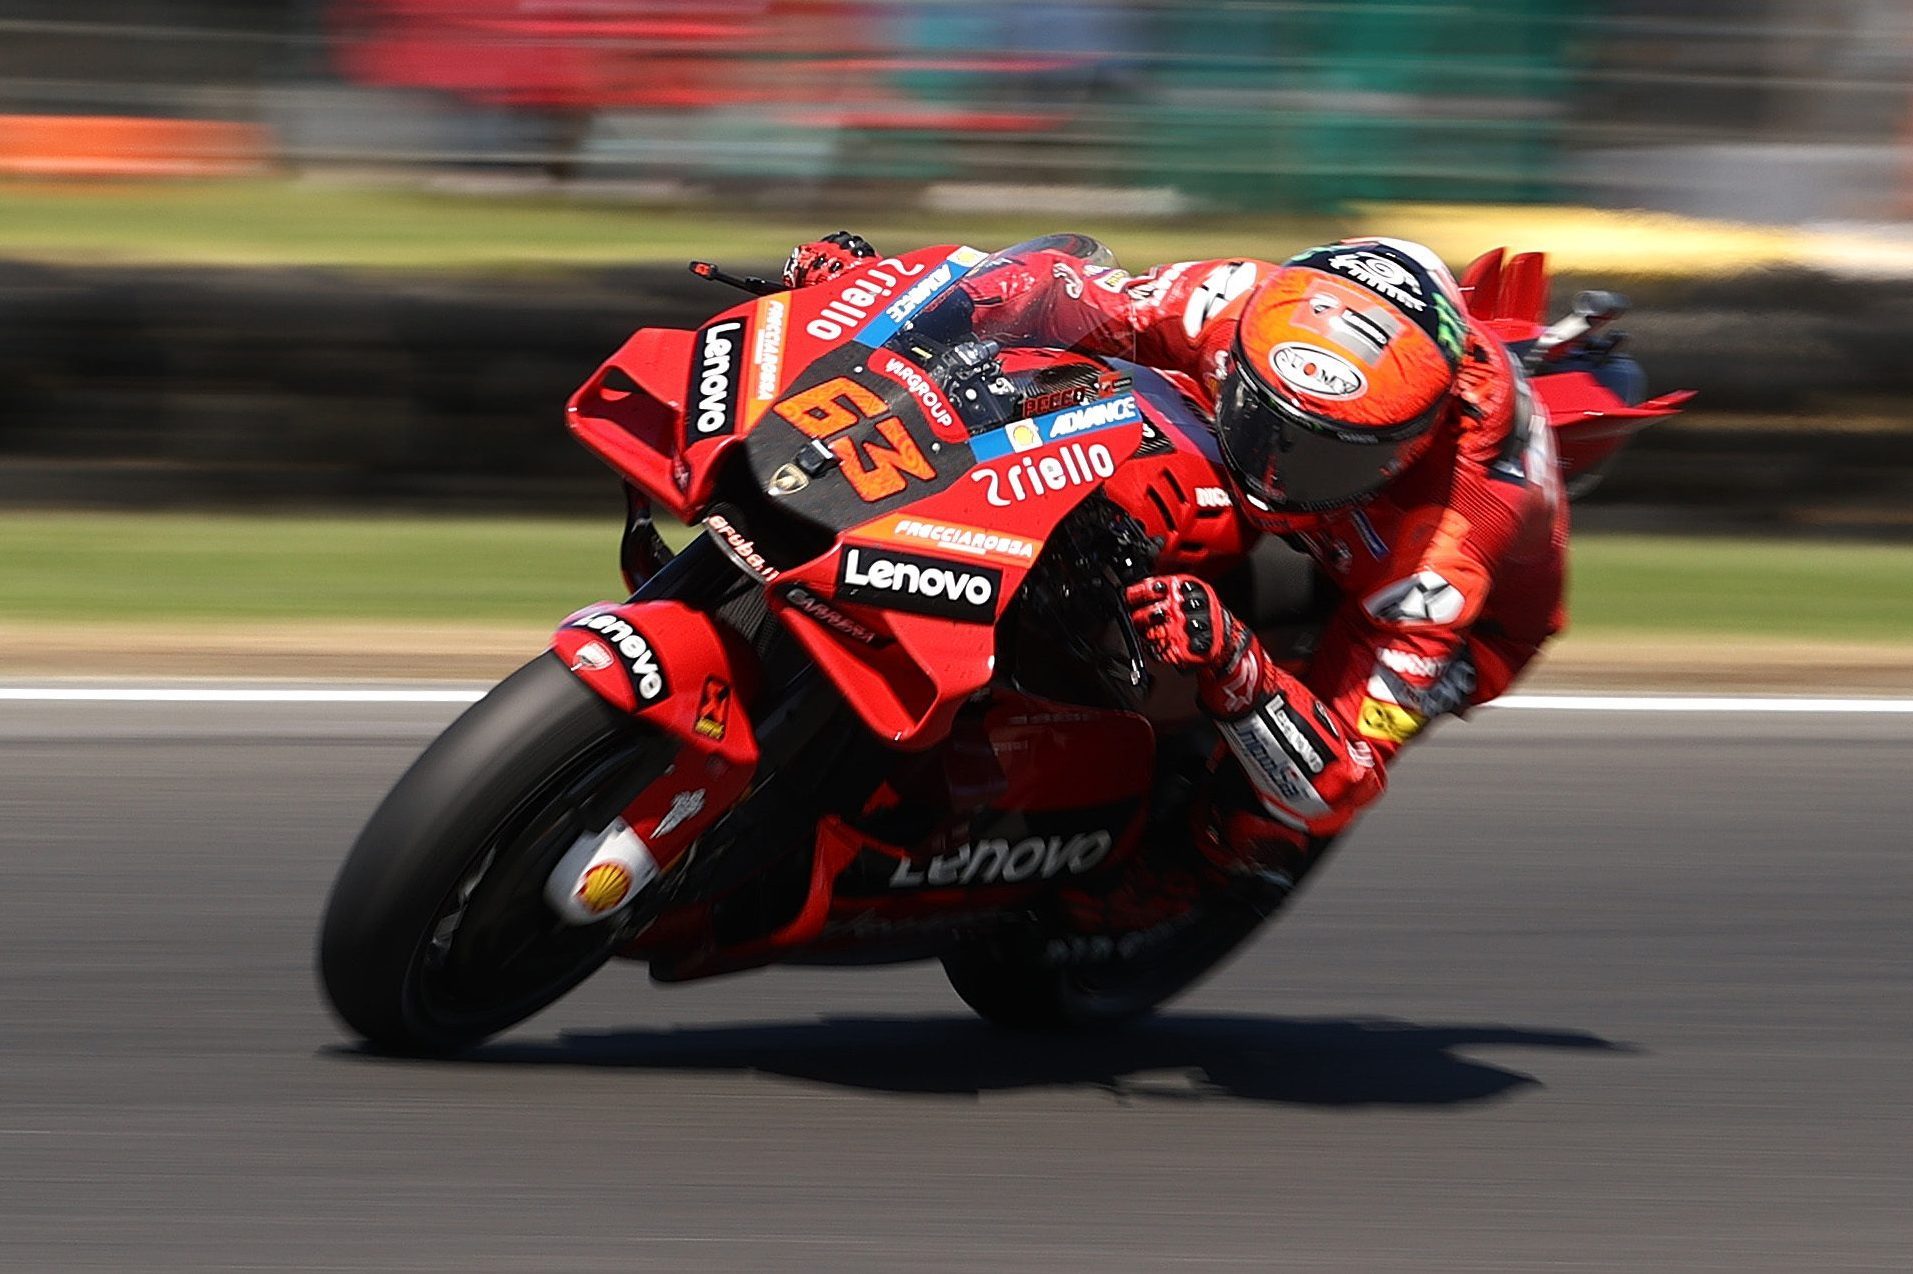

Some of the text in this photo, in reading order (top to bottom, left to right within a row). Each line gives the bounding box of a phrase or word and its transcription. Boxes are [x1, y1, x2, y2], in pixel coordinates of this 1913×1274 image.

[696, 322, 741, 433] Lenovo
[1050, 396, 1137, 438] ADVANCE
[772, 375, 938, 503] 63
[844, 548, 992, 605] Lenovo
[571, 612, 663, 700] Lenovo
